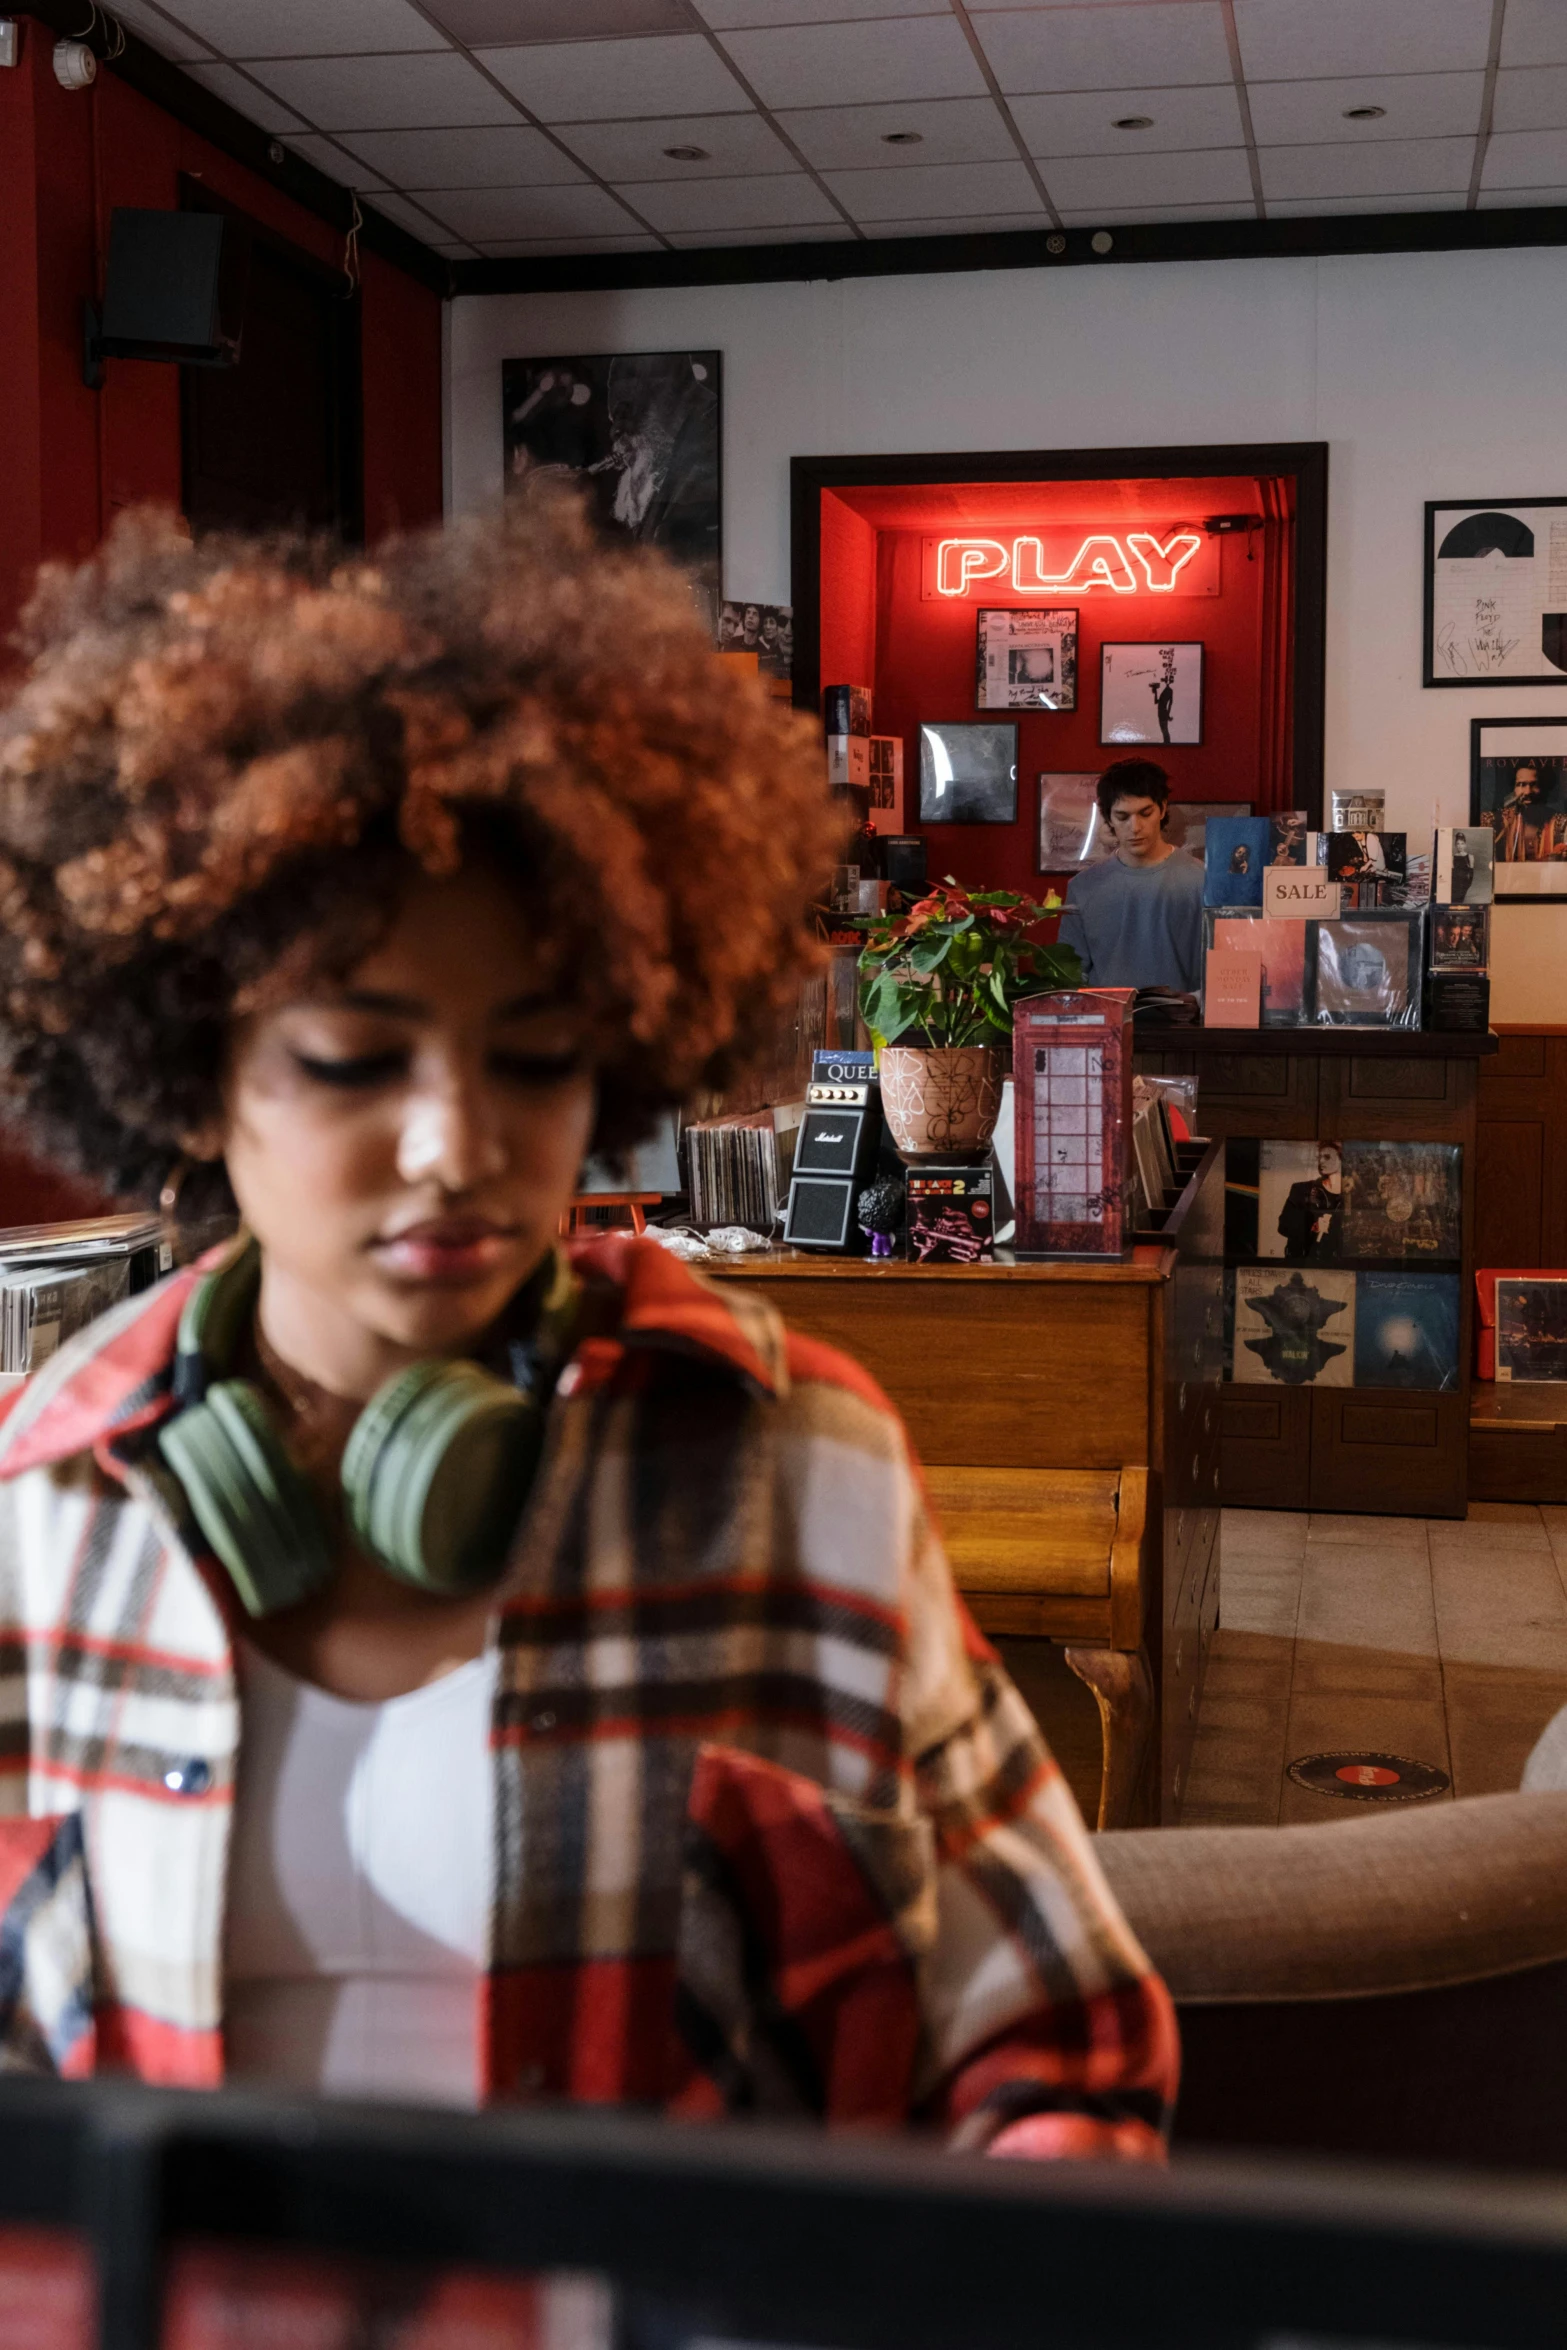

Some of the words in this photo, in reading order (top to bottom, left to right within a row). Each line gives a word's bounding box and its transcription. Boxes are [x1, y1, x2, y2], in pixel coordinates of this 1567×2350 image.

[937, 533, 1201, 595] PLAY
[1275, 883, 1328, 899] SALE
[827, 1064, 878, 1082] QUEE
